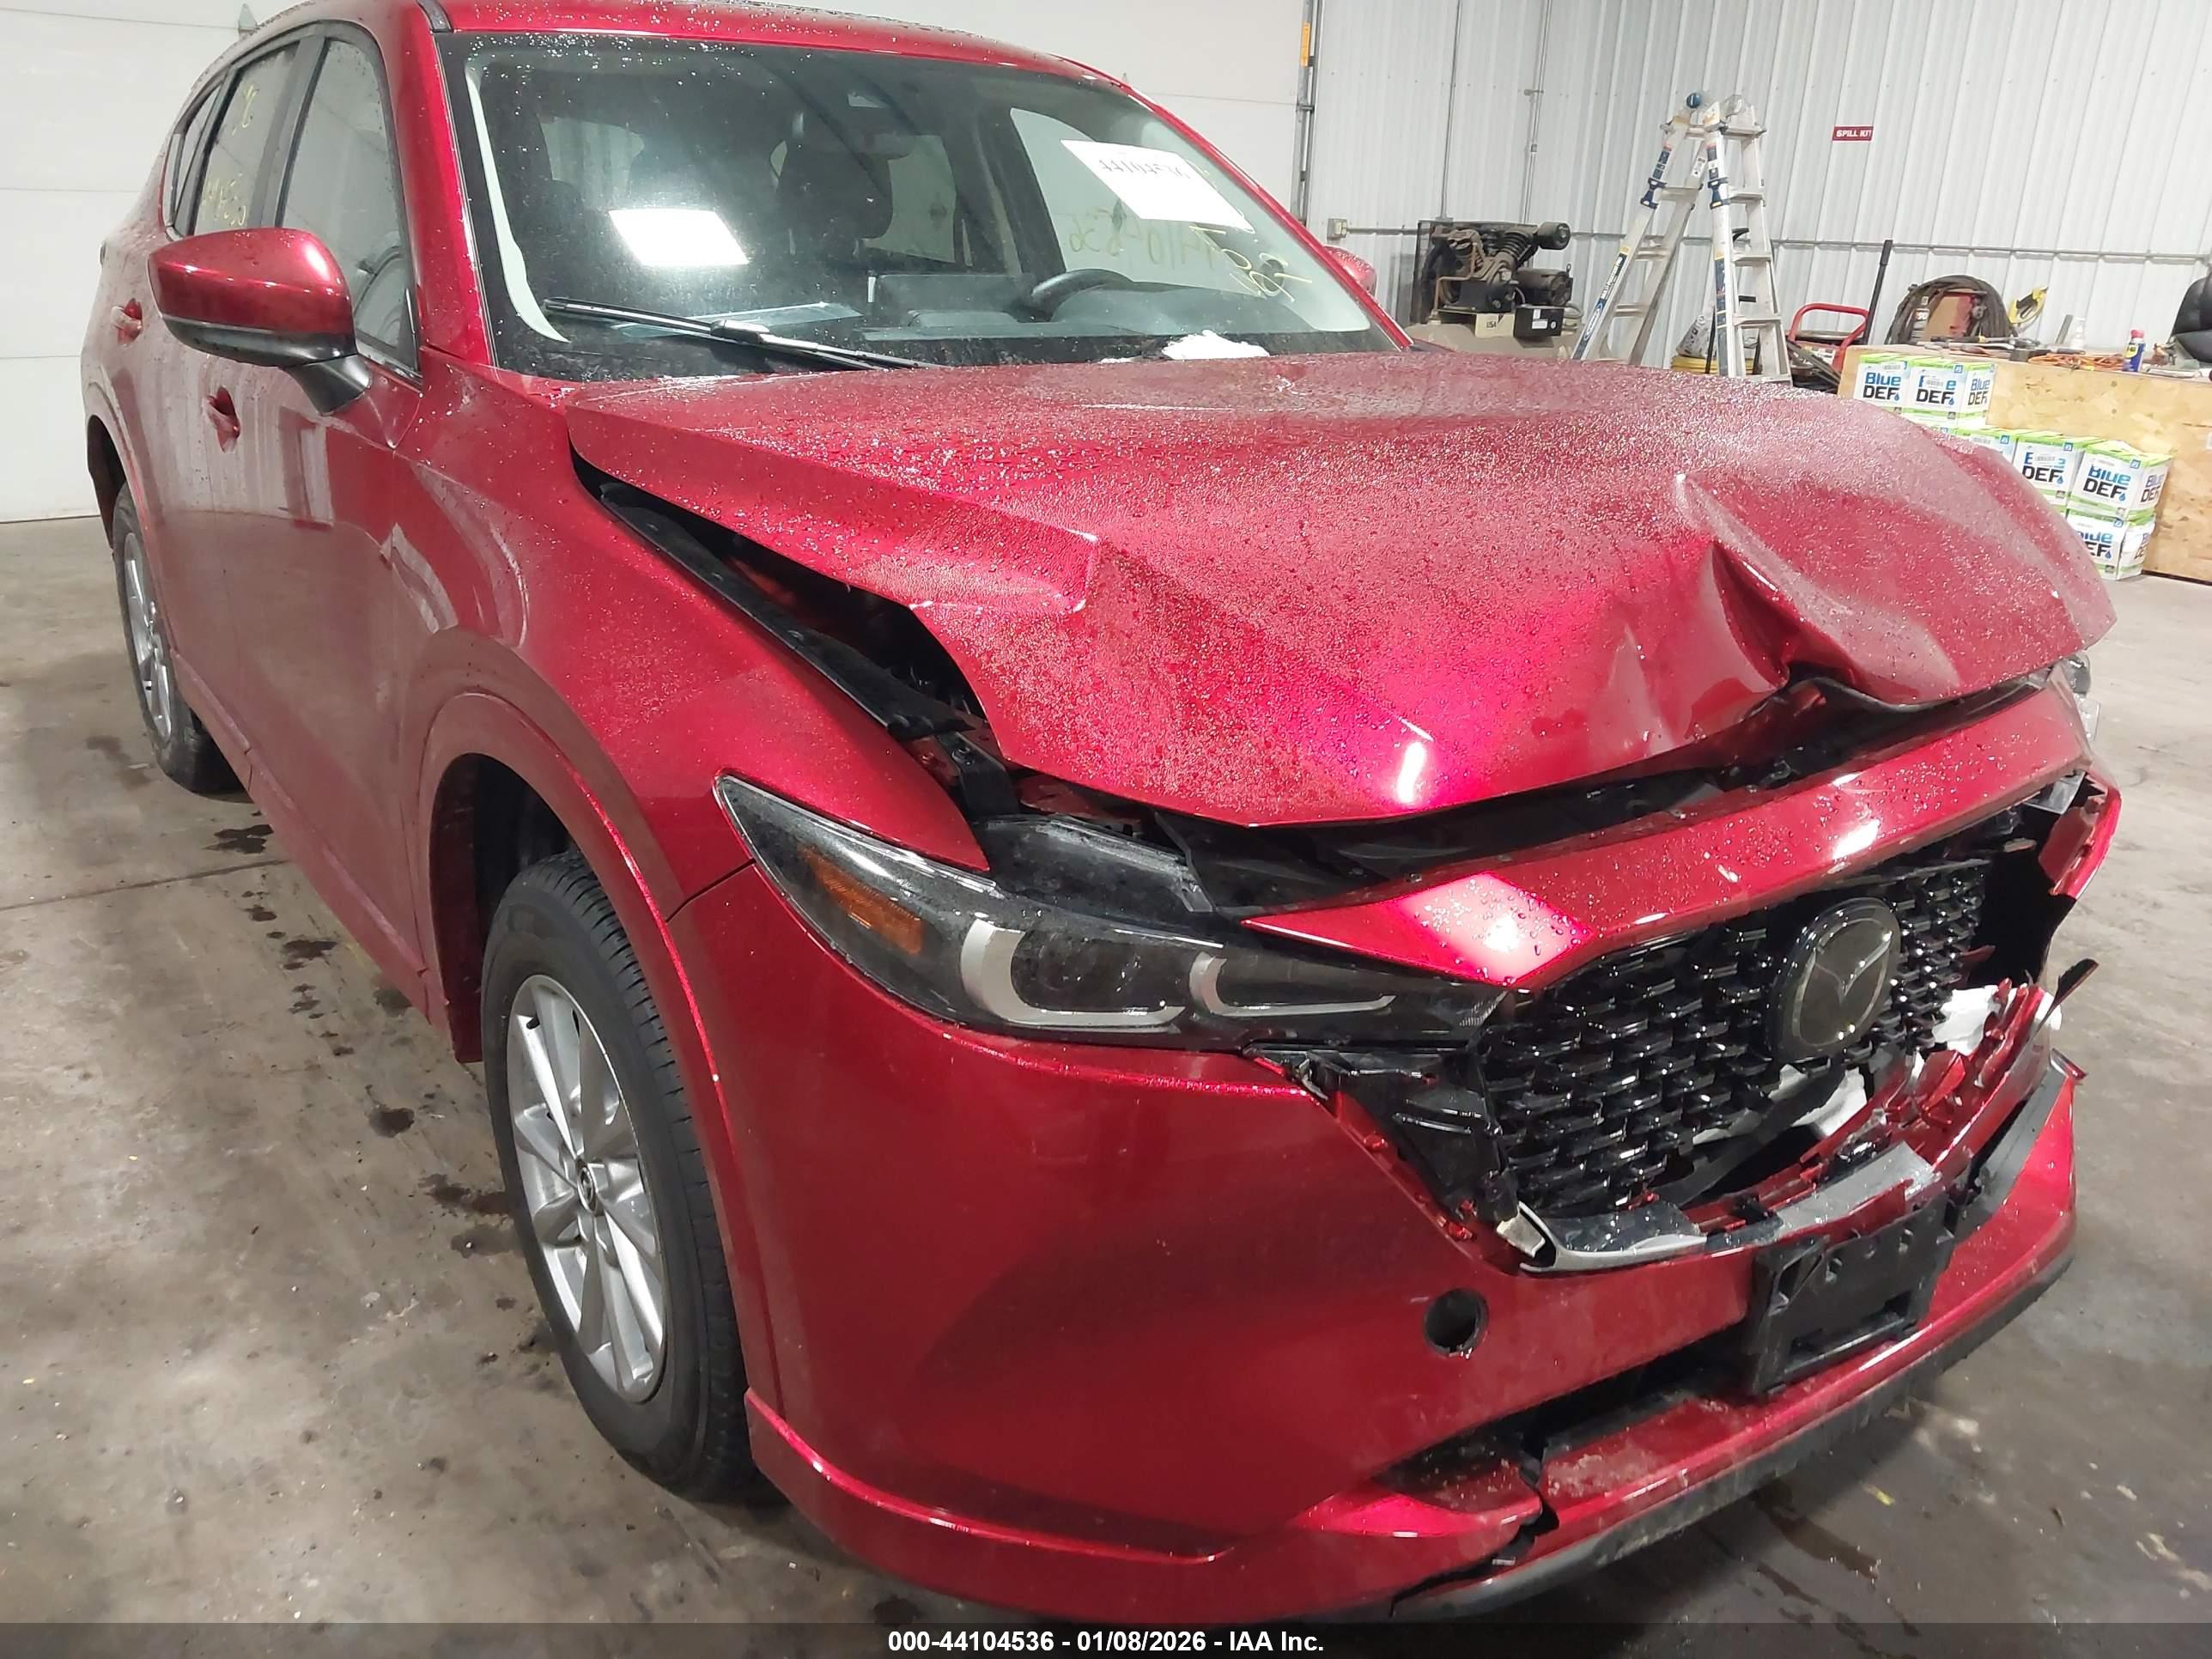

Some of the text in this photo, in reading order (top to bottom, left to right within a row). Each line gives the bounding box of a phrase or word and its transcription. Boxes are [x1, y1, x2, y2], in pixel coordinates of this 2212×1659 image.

[1865, 372, 1902, 386] Blue
[1971, 379, 1990, 391] Blue
[1863, 386, 1899, 400] DEF
[1916, 389, 1955, 404] DEF
[1967, 391, 1988, 405] DEF
[2022, 465, 2065, 483] DEF
[2087, 465, 2131, 486] Blue
[2083, 478, 2128, 499] DEF
[2141, 485, 2160, 502] DEF
